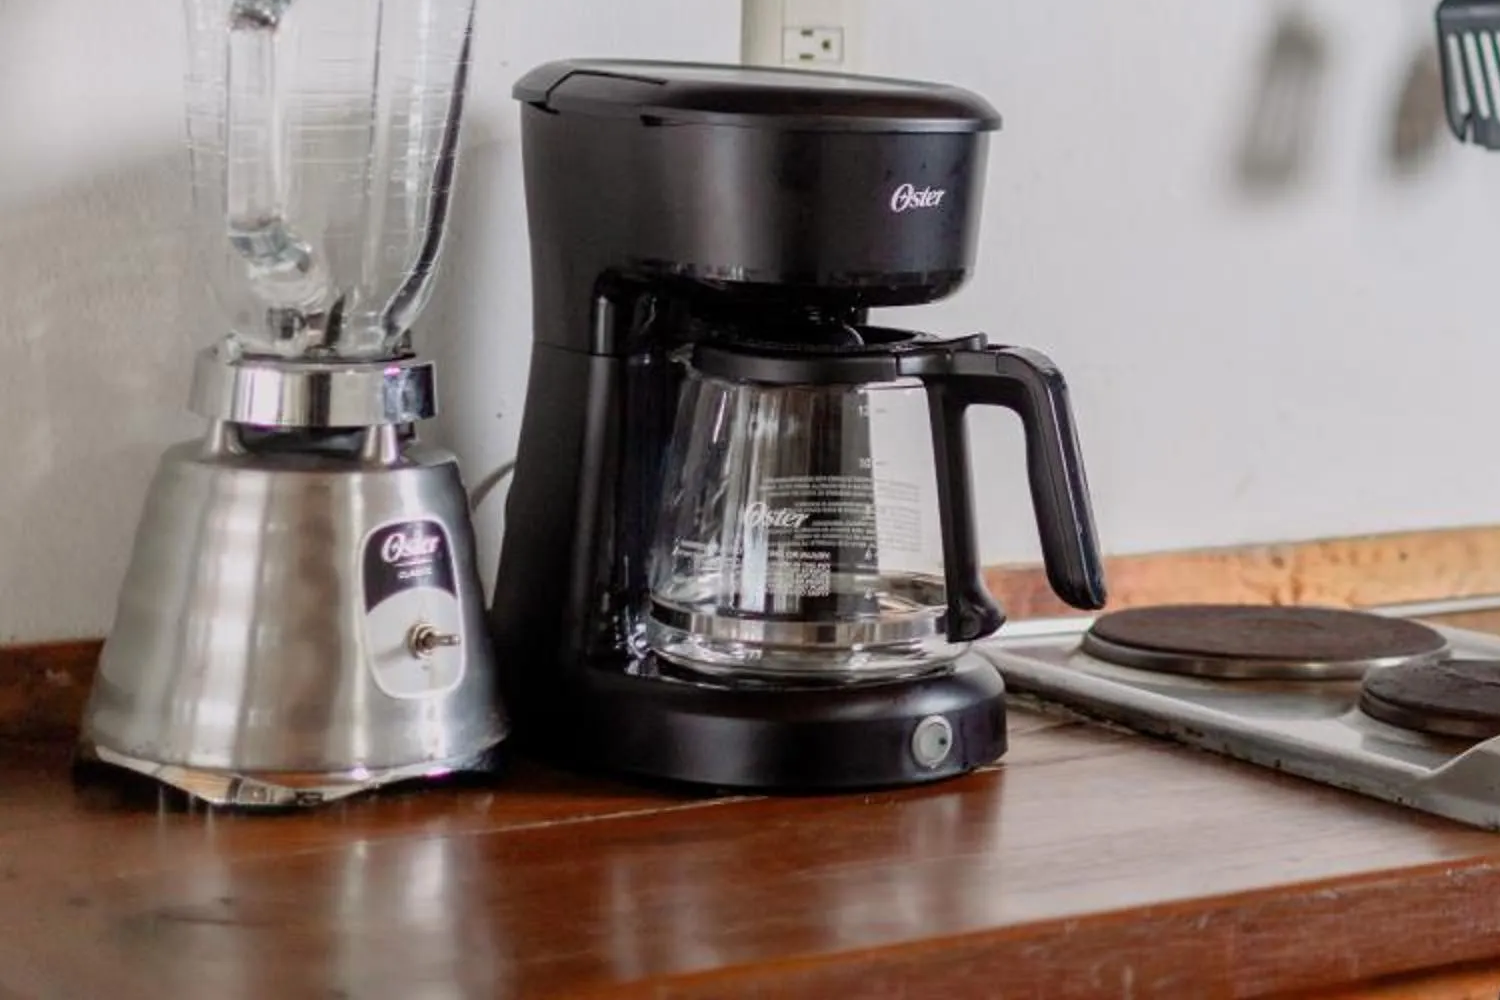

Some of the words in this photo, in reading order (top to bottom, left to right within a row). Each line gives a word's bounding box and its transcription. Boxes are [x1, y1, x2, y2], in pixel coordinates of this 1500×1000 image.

[890, 183, 945, 213] Oster
[743, 502, 809, 528] Oster
[381, 532, 440, 563] Oster
